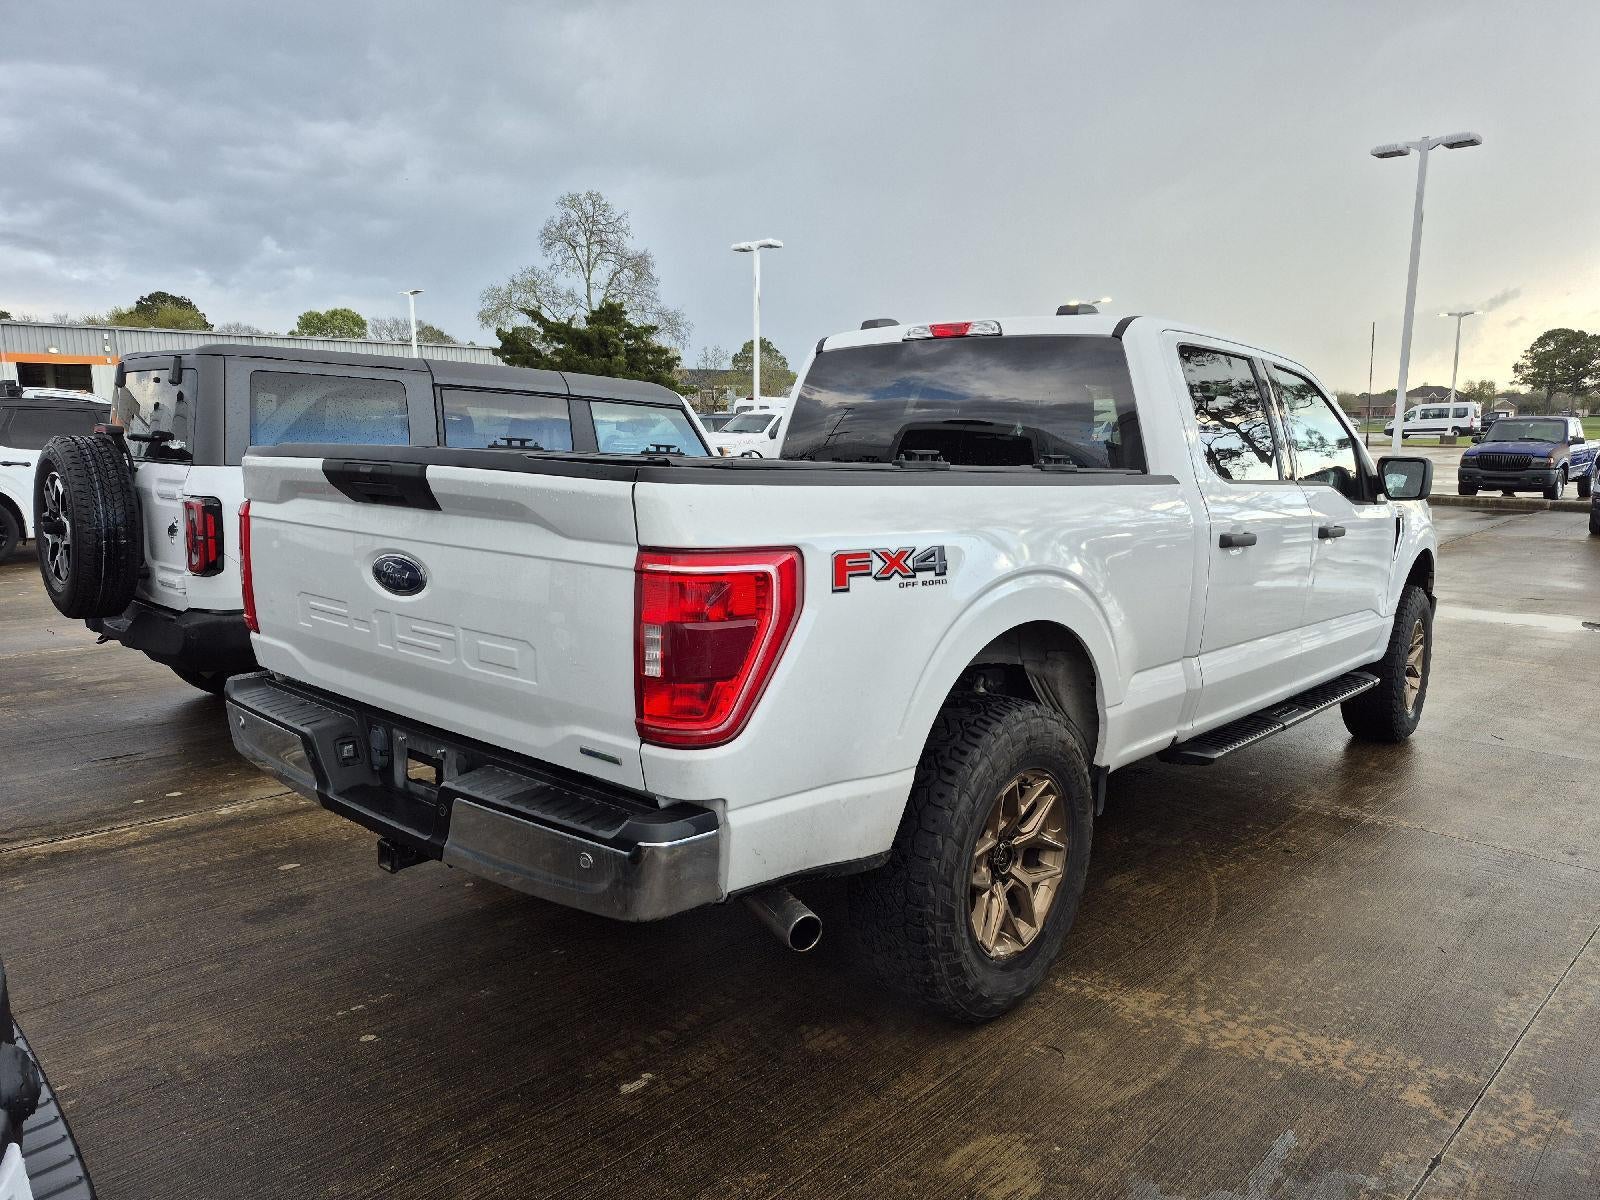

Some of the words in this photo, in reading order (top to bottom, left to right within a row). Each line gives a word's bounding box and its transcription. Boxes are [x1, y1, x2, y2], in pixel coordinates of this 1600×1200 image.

[381, 561, 411, 588] Ford
[831, 545, 947, 593] FX4
[898, 581, 918, 589] OFF
[921, 578, 948, 587] ROAD
[298, 591, 537, 685] F-150
